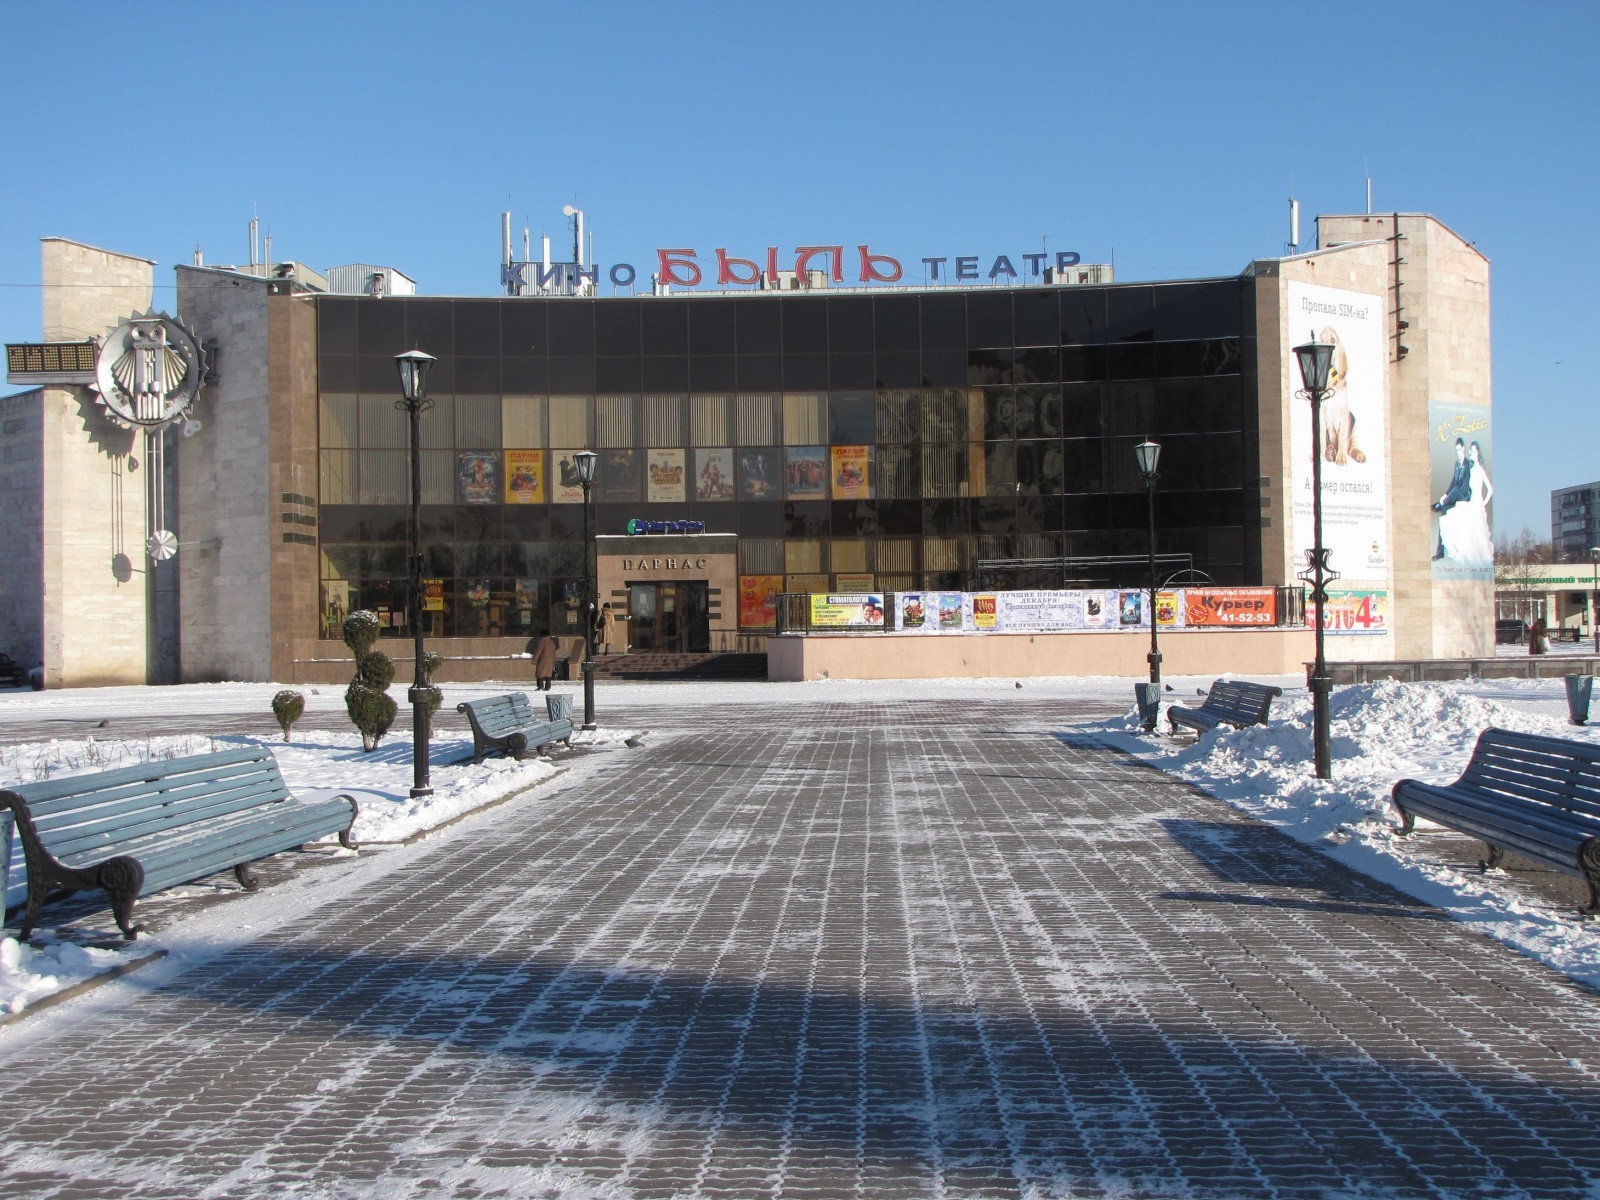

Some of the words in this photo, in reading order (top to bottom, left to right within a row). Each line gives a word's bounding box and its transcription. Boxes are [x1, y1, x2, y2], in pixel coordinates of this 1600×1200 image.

[500, 263, 636, 287] КИНО
[656, 245, 903, 286] БЫЛЬ
[921, 251, 1081, 280] ТЕАТР
[1302, 296, 1337, 315] Пропала
[1338, 303, 1370, 321] SIM-ка?
[835, 448, 865, 456] ПАРНИ
[1304, 477, 1311, 491] А
[1339, 481, 1373, 494] остался!
[623, 558, 707, 571] ПАРНАС
[1201, 595, 1265, 611] Курьер
[1220, 612, 1271, 623] 41-52-53
